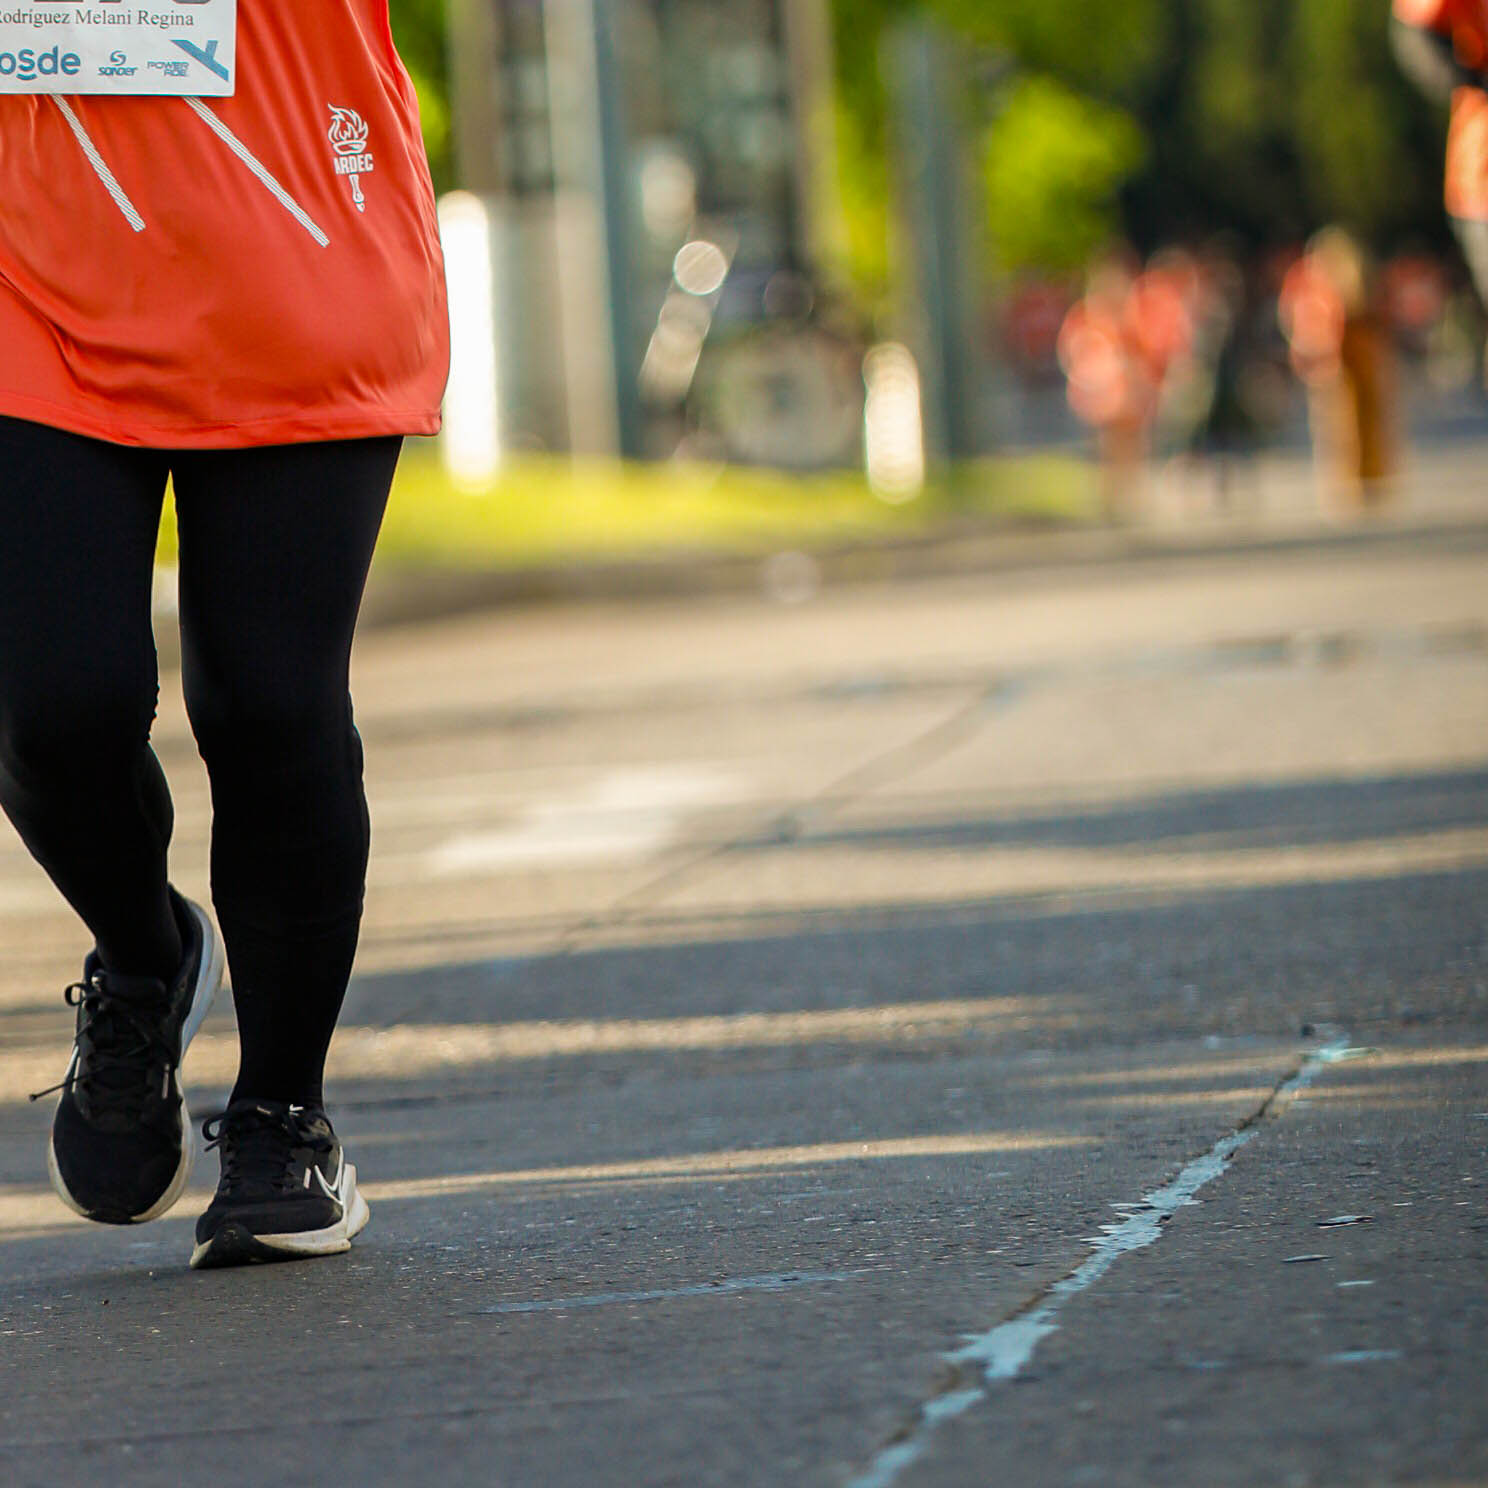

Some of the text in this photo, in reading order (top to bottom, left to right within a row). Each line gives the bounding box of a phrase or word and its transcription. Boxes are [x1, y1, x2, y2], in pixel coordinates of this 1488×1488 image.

[75, 10, 132, 25] Melani
[138, 11, 195, 29] Regina
[334, 154, 374, 175] ARDEC
